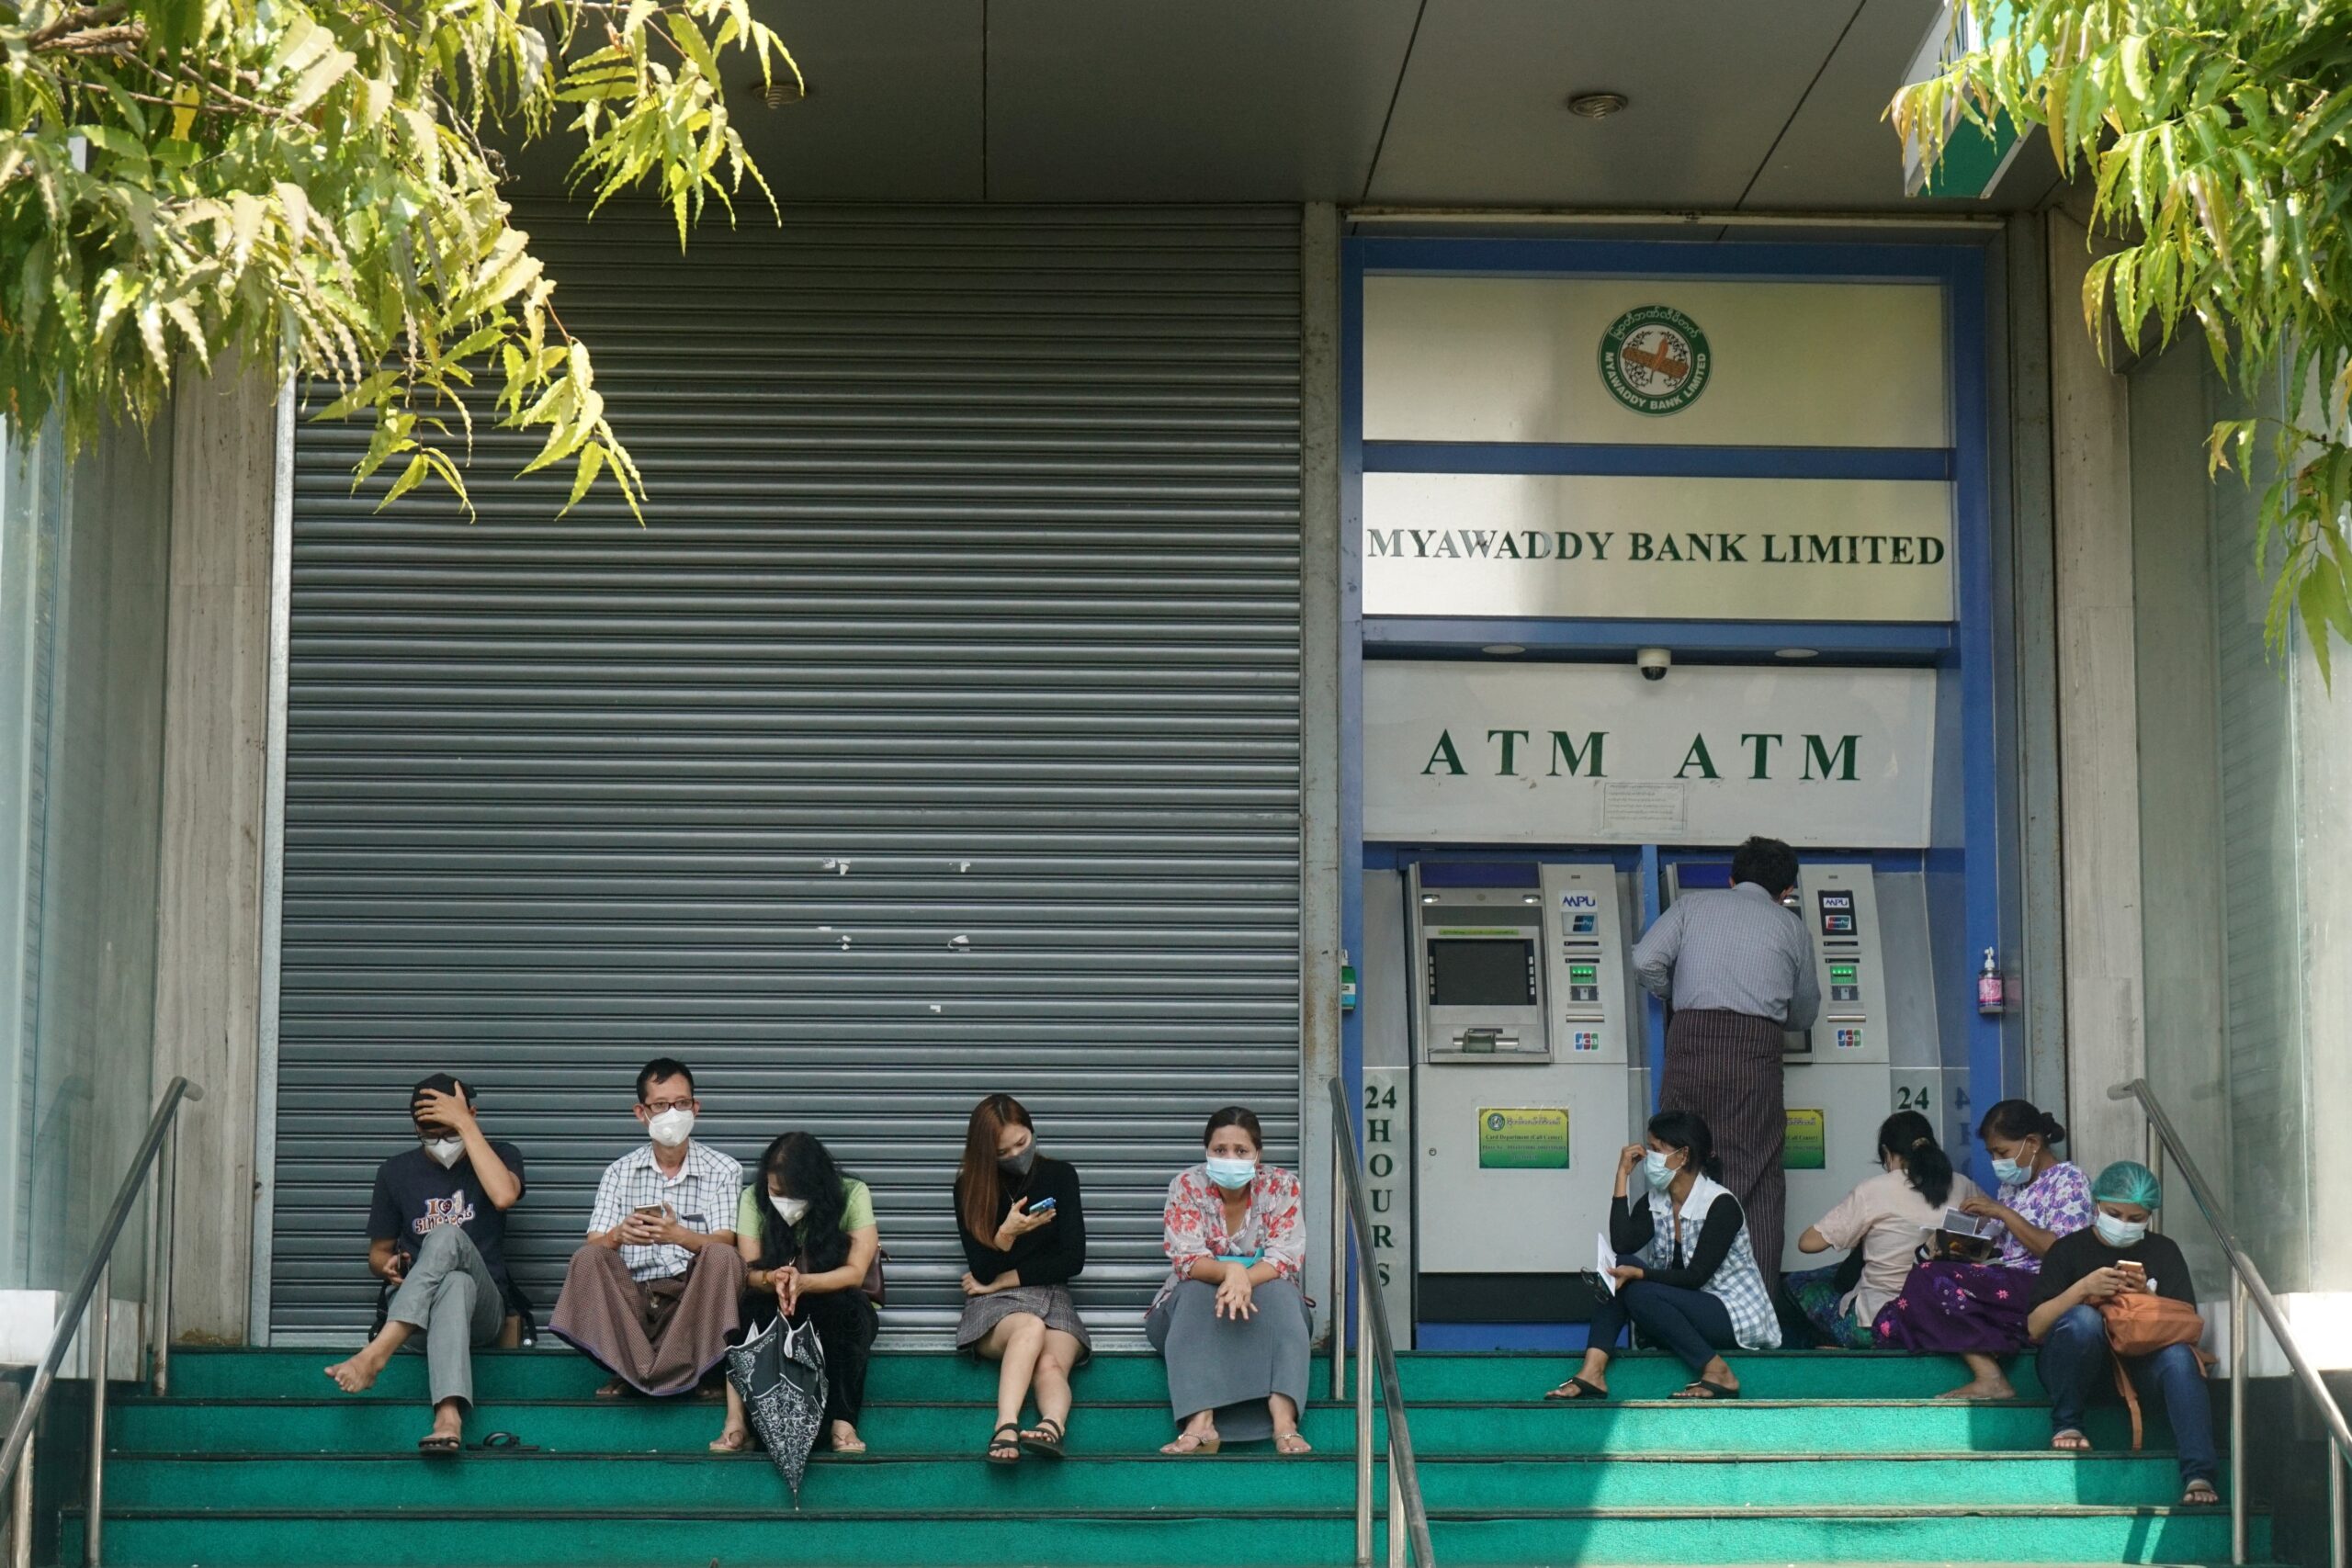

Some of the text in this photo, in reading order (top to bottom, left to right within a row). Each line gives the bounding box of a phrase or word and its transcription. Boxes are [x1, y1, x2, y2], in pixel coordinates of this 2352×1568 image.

[1605, 352, 1707, 410] MYAWADDY BANK LIMITED
[1367, 528, 1945, 565] MYAWADDY BANK LIMITED
[1420, 728, 1863, 781] ATM ATM
[1562, 896, 1596, 907] MPU
[1897, 1087, 1929, 1110] 24
[1365, 1086, 1396, 1287] 24 HOURS
[425, 1199, 439, 1217] I
